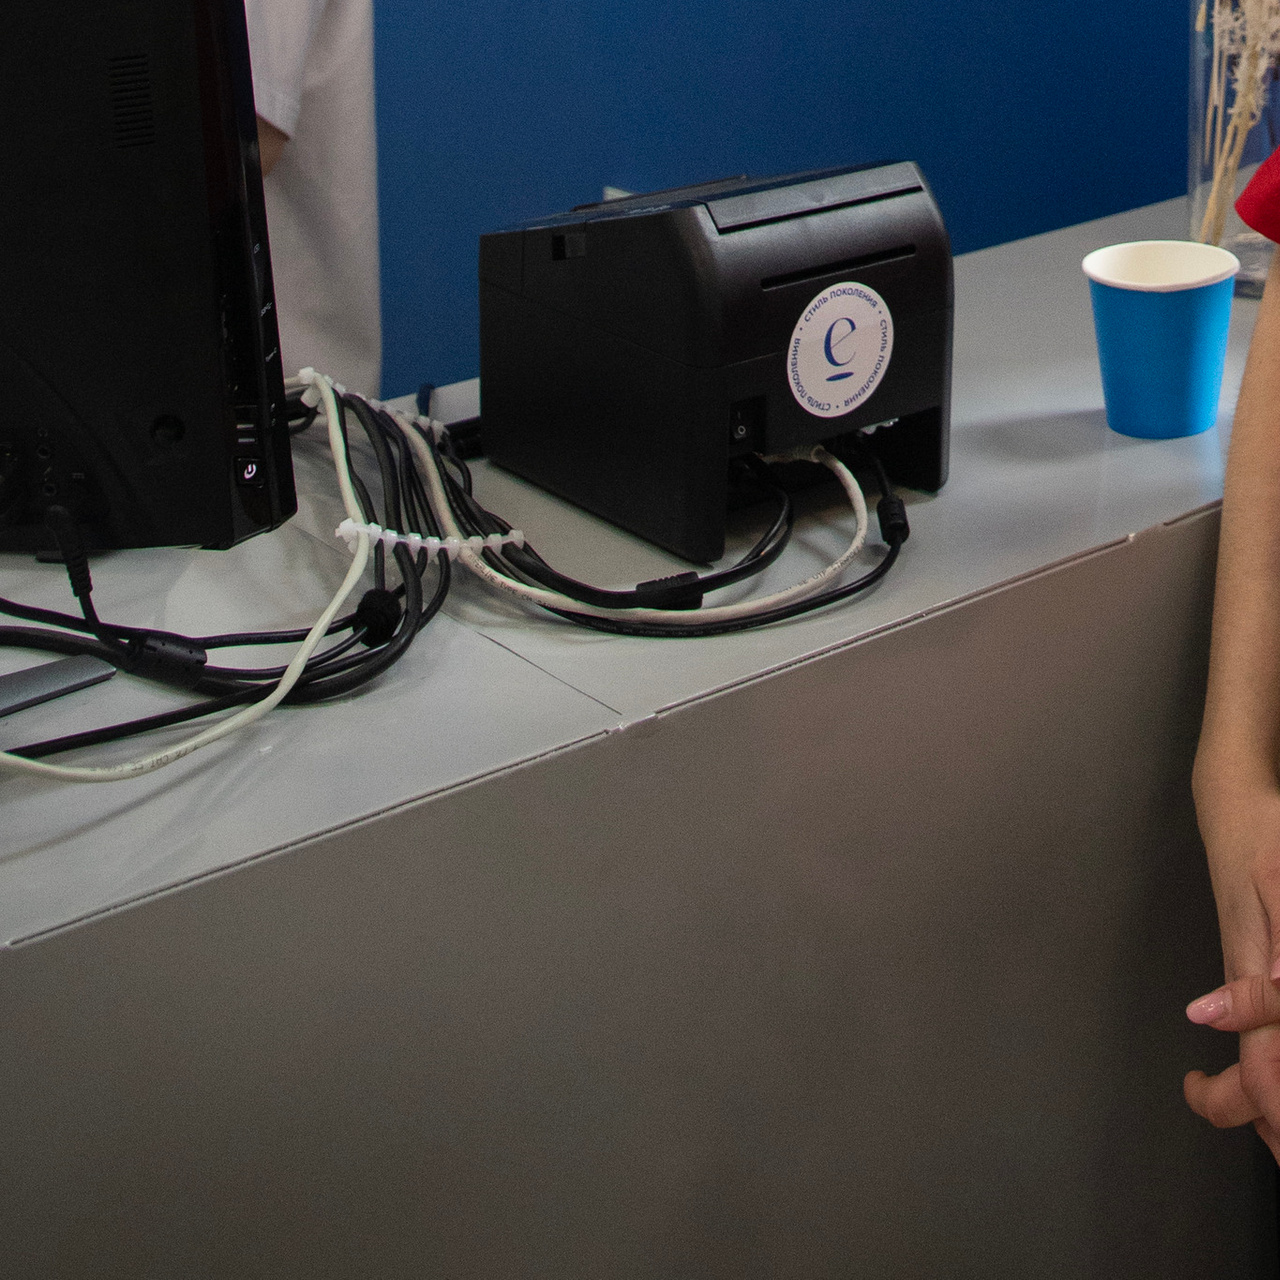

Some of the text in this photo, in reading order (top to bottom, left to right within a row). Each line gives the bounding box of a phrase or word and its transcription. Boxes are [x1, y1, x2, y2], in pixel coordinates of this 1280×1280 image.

[804, 287, 878, 323] СТИЛЬ ПОКОЛЕНИЯ
[790, 337, 831, 412] СТИЛЬ ПОКОЛЕНИЯ
[843, 319, 889, 407] СТИЛЬ ПОКОЛЕНИЯ
